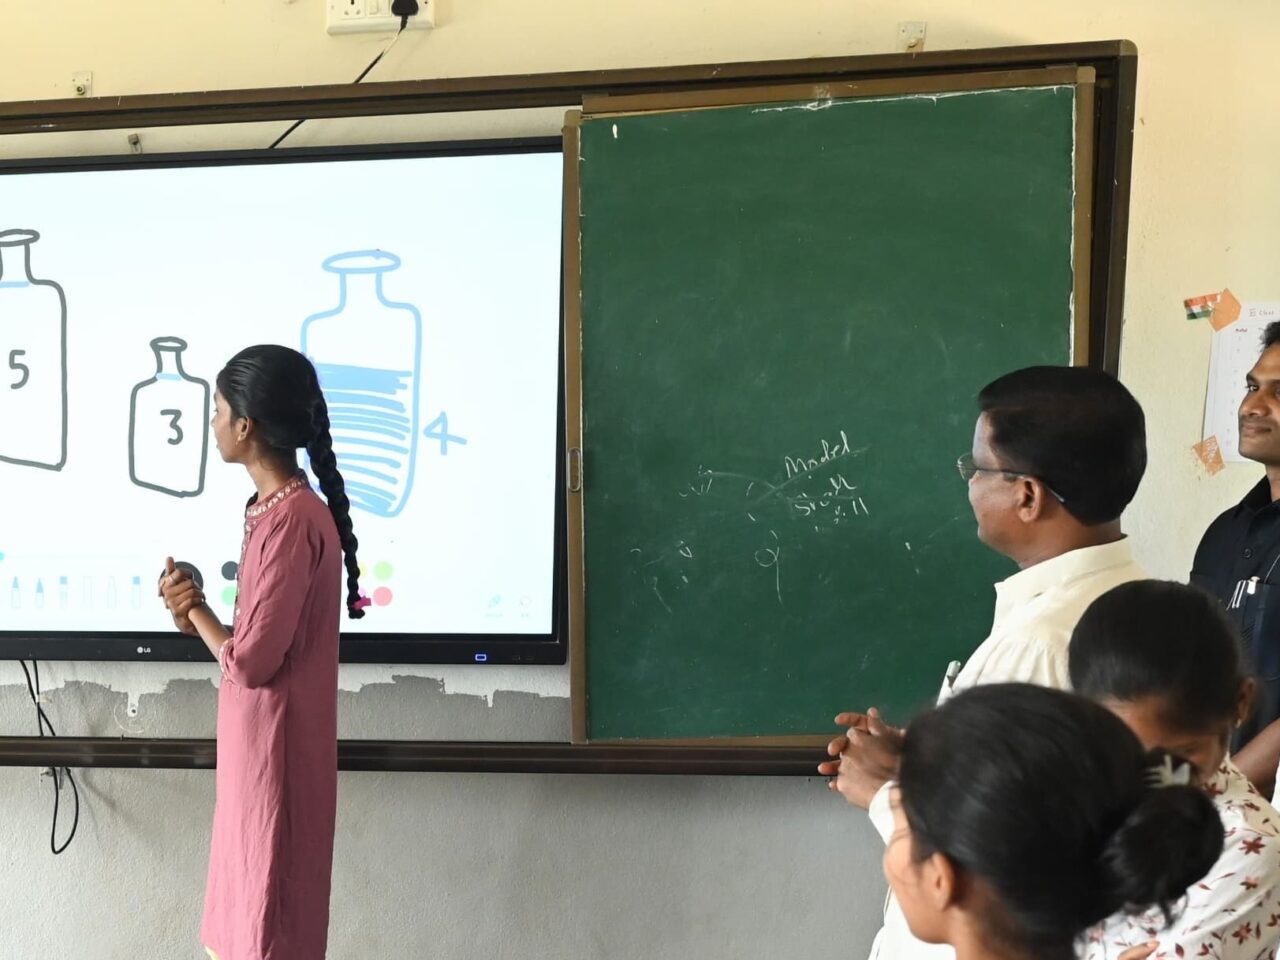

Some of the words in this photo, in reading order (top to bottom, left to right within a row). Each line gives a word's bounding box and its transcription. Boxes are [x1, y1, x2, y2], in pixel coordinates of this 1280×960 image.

[8, 349, 30, 390] 5
[160, 408, 184, 446] 3
[423, 411, 468, 456] 4
